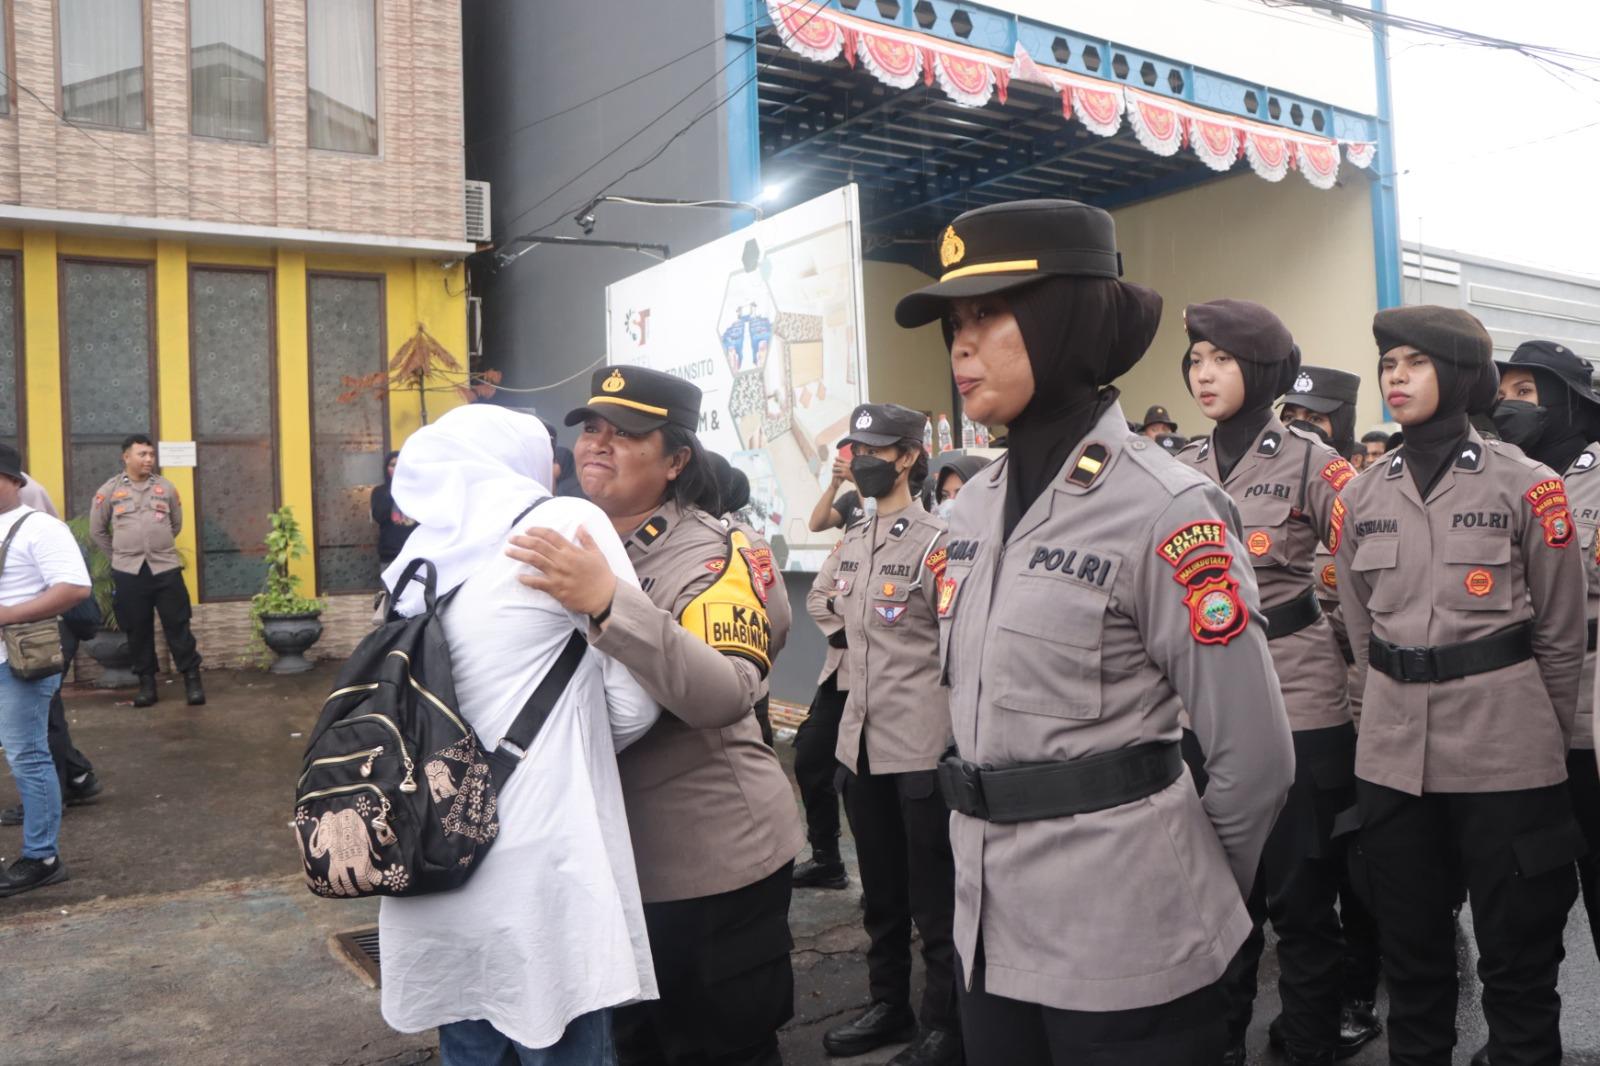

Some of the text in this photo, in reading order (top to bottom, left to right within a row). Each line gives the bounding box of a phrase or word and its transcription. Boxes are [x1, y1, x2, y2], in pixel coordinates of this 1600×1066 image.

[711, 409, 720, 431] &
[1244, 483, 1291, 499] POLRI
[1530, 481, 1562, 500] POLDA
[1452, 512, 1508, 529] POLRI
[1163, 524, 1221, 555] POLRES
[1169, 534, 1220, 560] TERNATE
[879, 564, 911, 577] POLRI
[1028, 546, 1112, 587] POLRI
